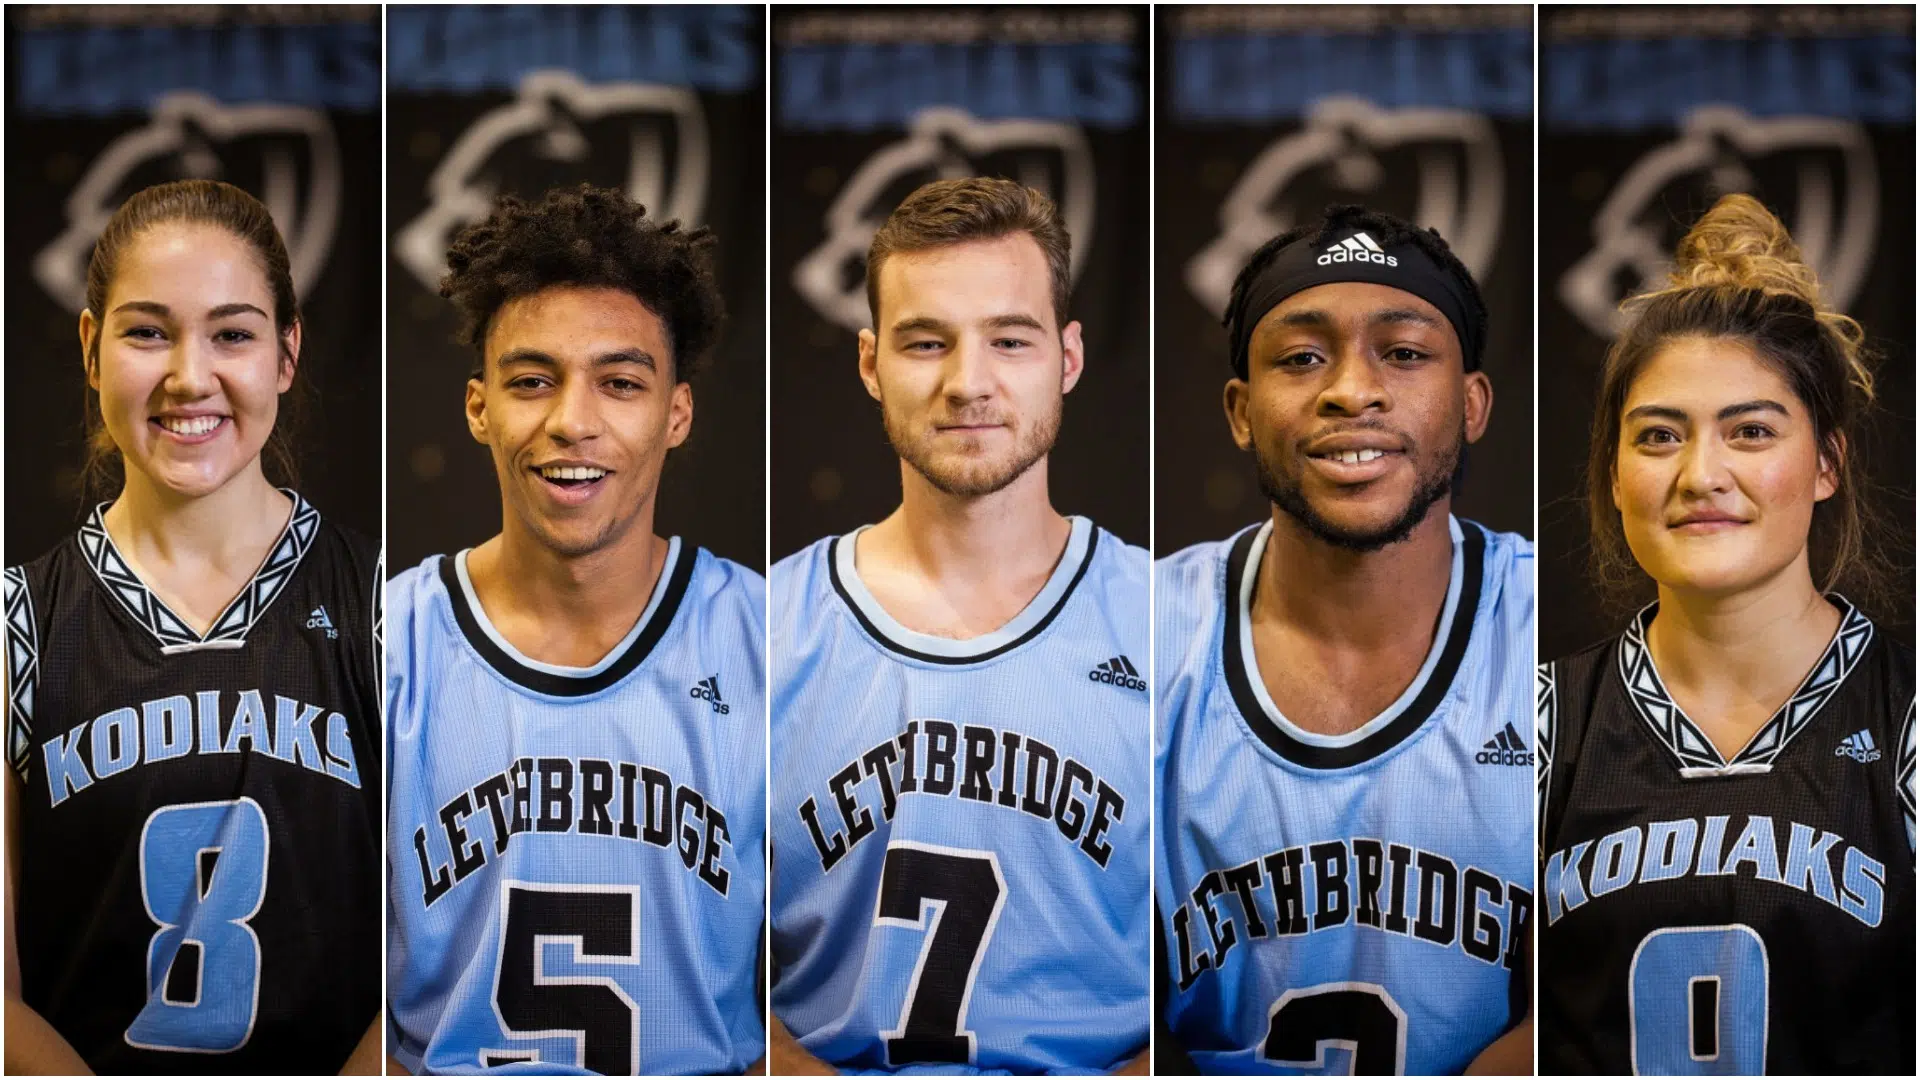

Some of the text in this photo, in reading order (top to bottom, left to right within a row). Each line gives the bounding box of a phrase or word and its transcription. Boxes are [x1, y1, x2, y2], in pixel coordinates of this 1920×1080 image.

[1317, 248, 1398, 267] adidas
[1089, 669, 1147, 692] adidas
[42, 689, 362, 808] KODIAKS
[1475, 748, 1534, 767] adidas
[413, 755, 733, 912] LETHBRIDGE
[1544, 814, 1886, 928] KODIAKS
[124, 796, 271, 1054] 8
[479, 879, 641, 1076] 5
[873, 839, 1009, 1067] 7
